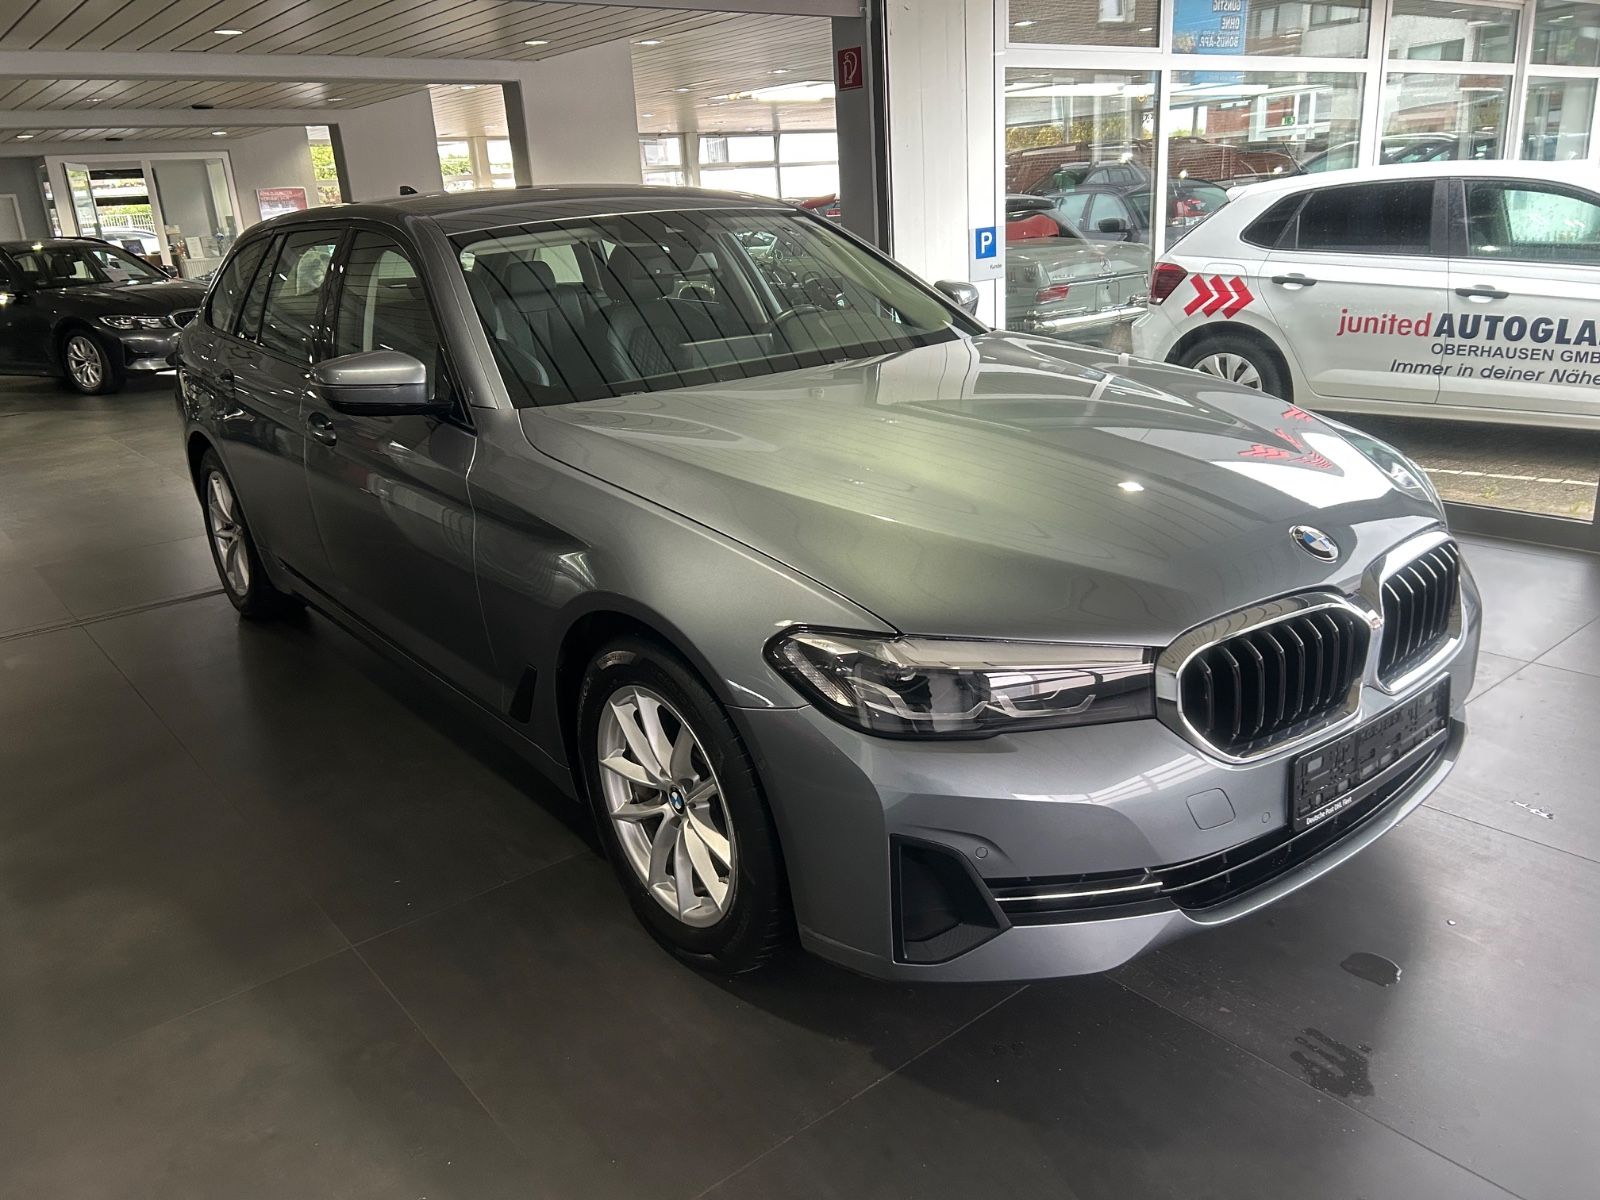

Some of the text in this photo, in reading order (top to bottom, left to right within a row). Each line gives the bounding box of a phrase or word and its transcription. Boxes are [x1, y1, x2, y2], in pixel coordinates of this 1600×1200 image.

[981, 231, 993, 254] P
[1337, 308, 1600, 346] junited AUTOGLA
[1431, 342, 1554, 361] OBERHAUSEN
[1390, 359, 1600, 386] Immer in deiner Nähe
